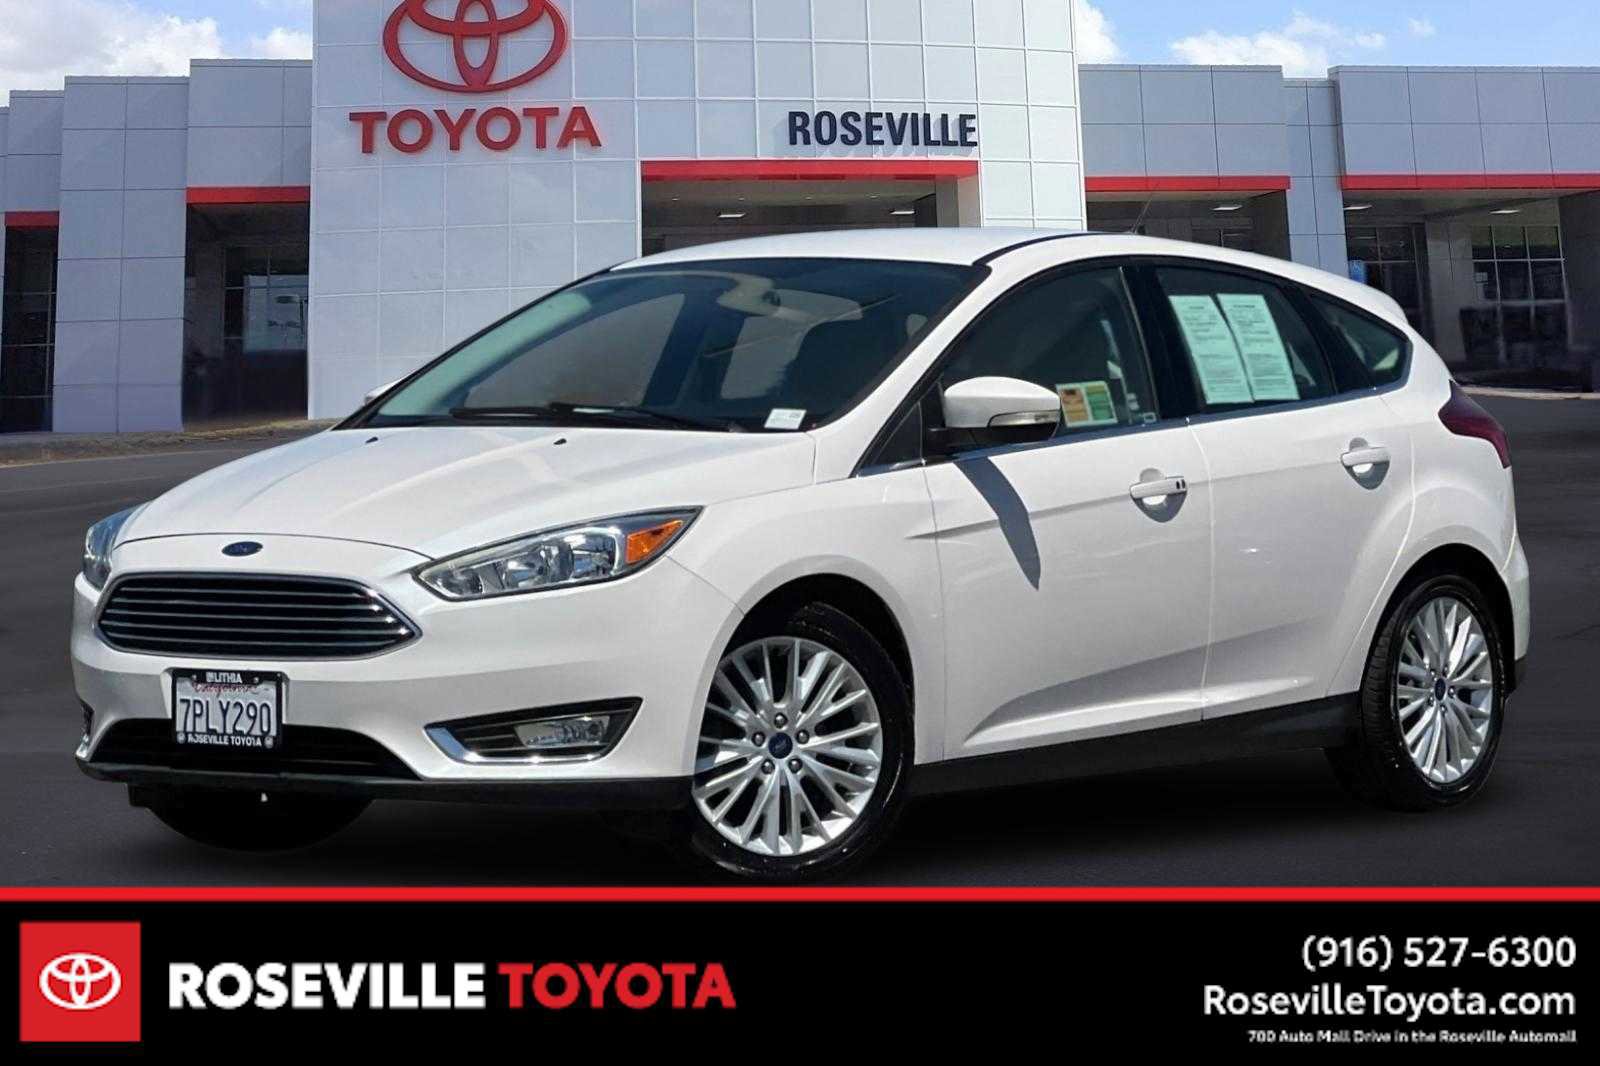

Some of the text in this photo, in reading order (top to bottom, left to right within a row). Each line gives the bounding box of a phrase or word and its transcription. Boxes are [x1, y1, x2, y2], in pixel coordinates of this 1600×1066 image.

[349, 106, 602, 154] TOYOTA
[789, 111, 978, 147] ROSEVILLE
[214, 672, 243, 683] LITHIA
[179, 698, 272, 736] 7PLY290
[230, 736, 262, 746] TOYOTA
